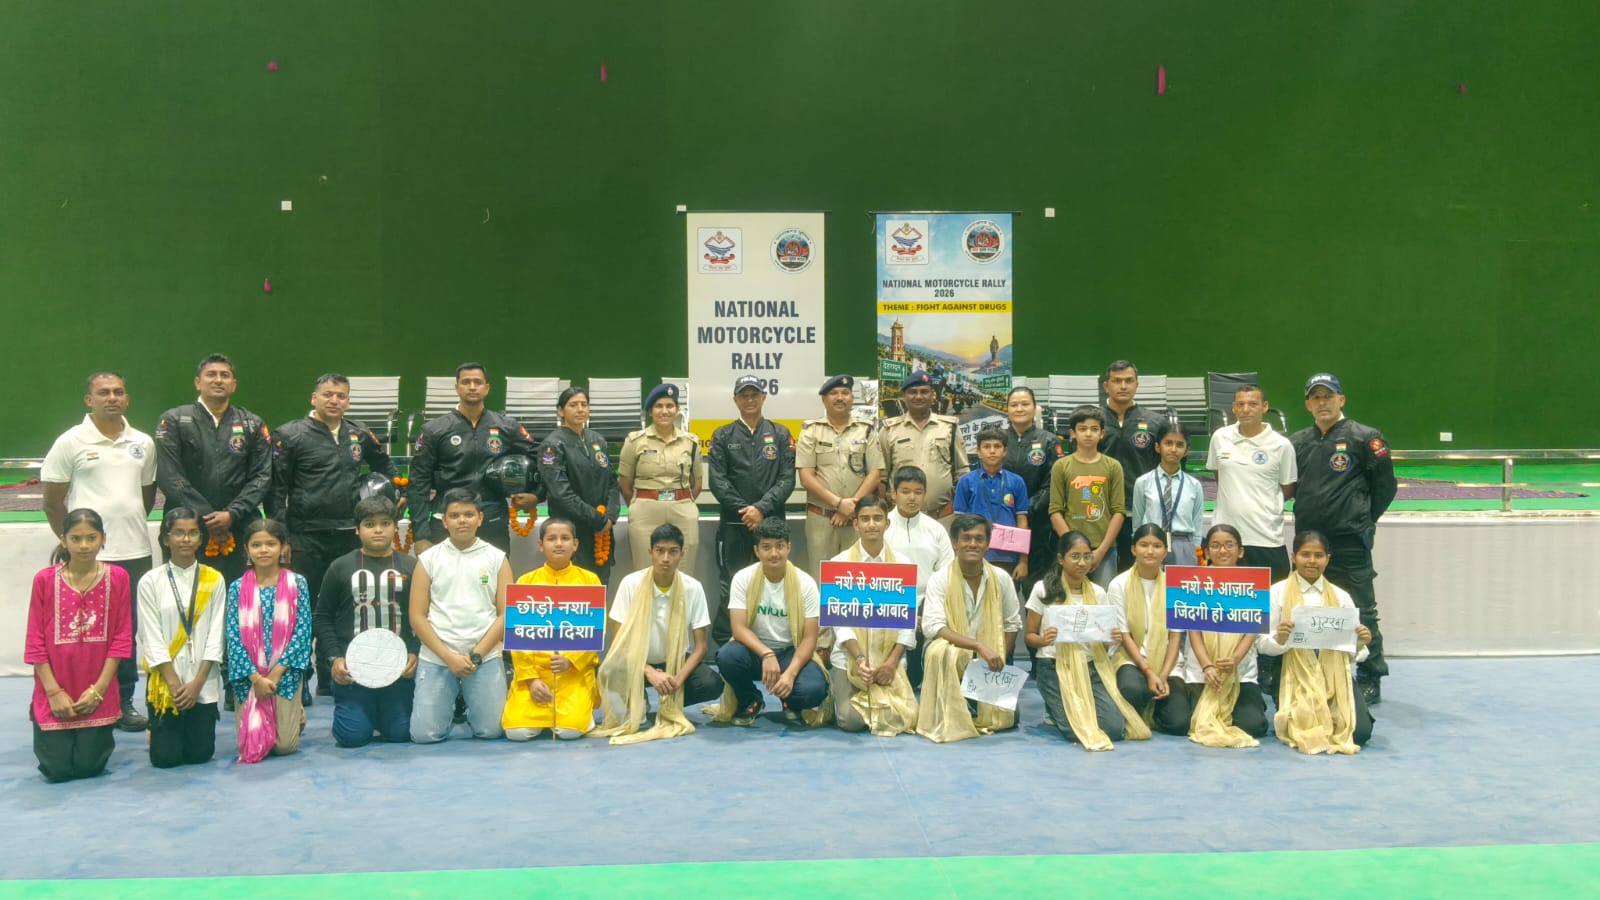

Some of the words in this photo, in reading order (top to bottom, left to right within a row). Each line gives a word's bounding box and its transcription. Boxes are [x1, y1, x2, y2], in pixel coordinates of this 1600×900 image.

[882, 279, 922, 288] NATIONAL
[925, 279, 979, 288] MOTORCYCLE
[982, 279, 1006, 288] RALLY
[934, 289, 955, 298] 2026
[714, 300, 800, 318] NATIONAL
[916, 303, 941, 311] FIGHT
[942, 303, 977, 311] AGAINST
[978, 303, 1007, 311] DRUGS
[697, 326, 816, 344] MOTORCYCLE
[731, 352, 784, 370] RALLY
[760, 378, 779, 396] 26
[834, 571, 854, 590] नशे
[856, 571, 867, 591] से
[869, 577, 905, 594] आज़ाद,
[1180, 575, 1201, 595] नशे
[1203, 576, 1215, 596] से
[1217, 581, 1258, 598] आज़ाद,
[515, 595, 555, 618] छोड़ो
[557, 600, 594, 617] नशा,
[757, 604, 788, 617] NIQL
[827, 596, 859, 618] जिंदगी
[862, 597, 874, 619] हो
[877, 603, 909, 619] आबाद
[1173, 600, 1208, 622] जिंदगी
[1211, 602, 1224, 623] हो
[1226, 607, 1263, 624] आबाद
[513, 620, 555, 640] बदलो
[559, 620, 595, 640] दिशा
